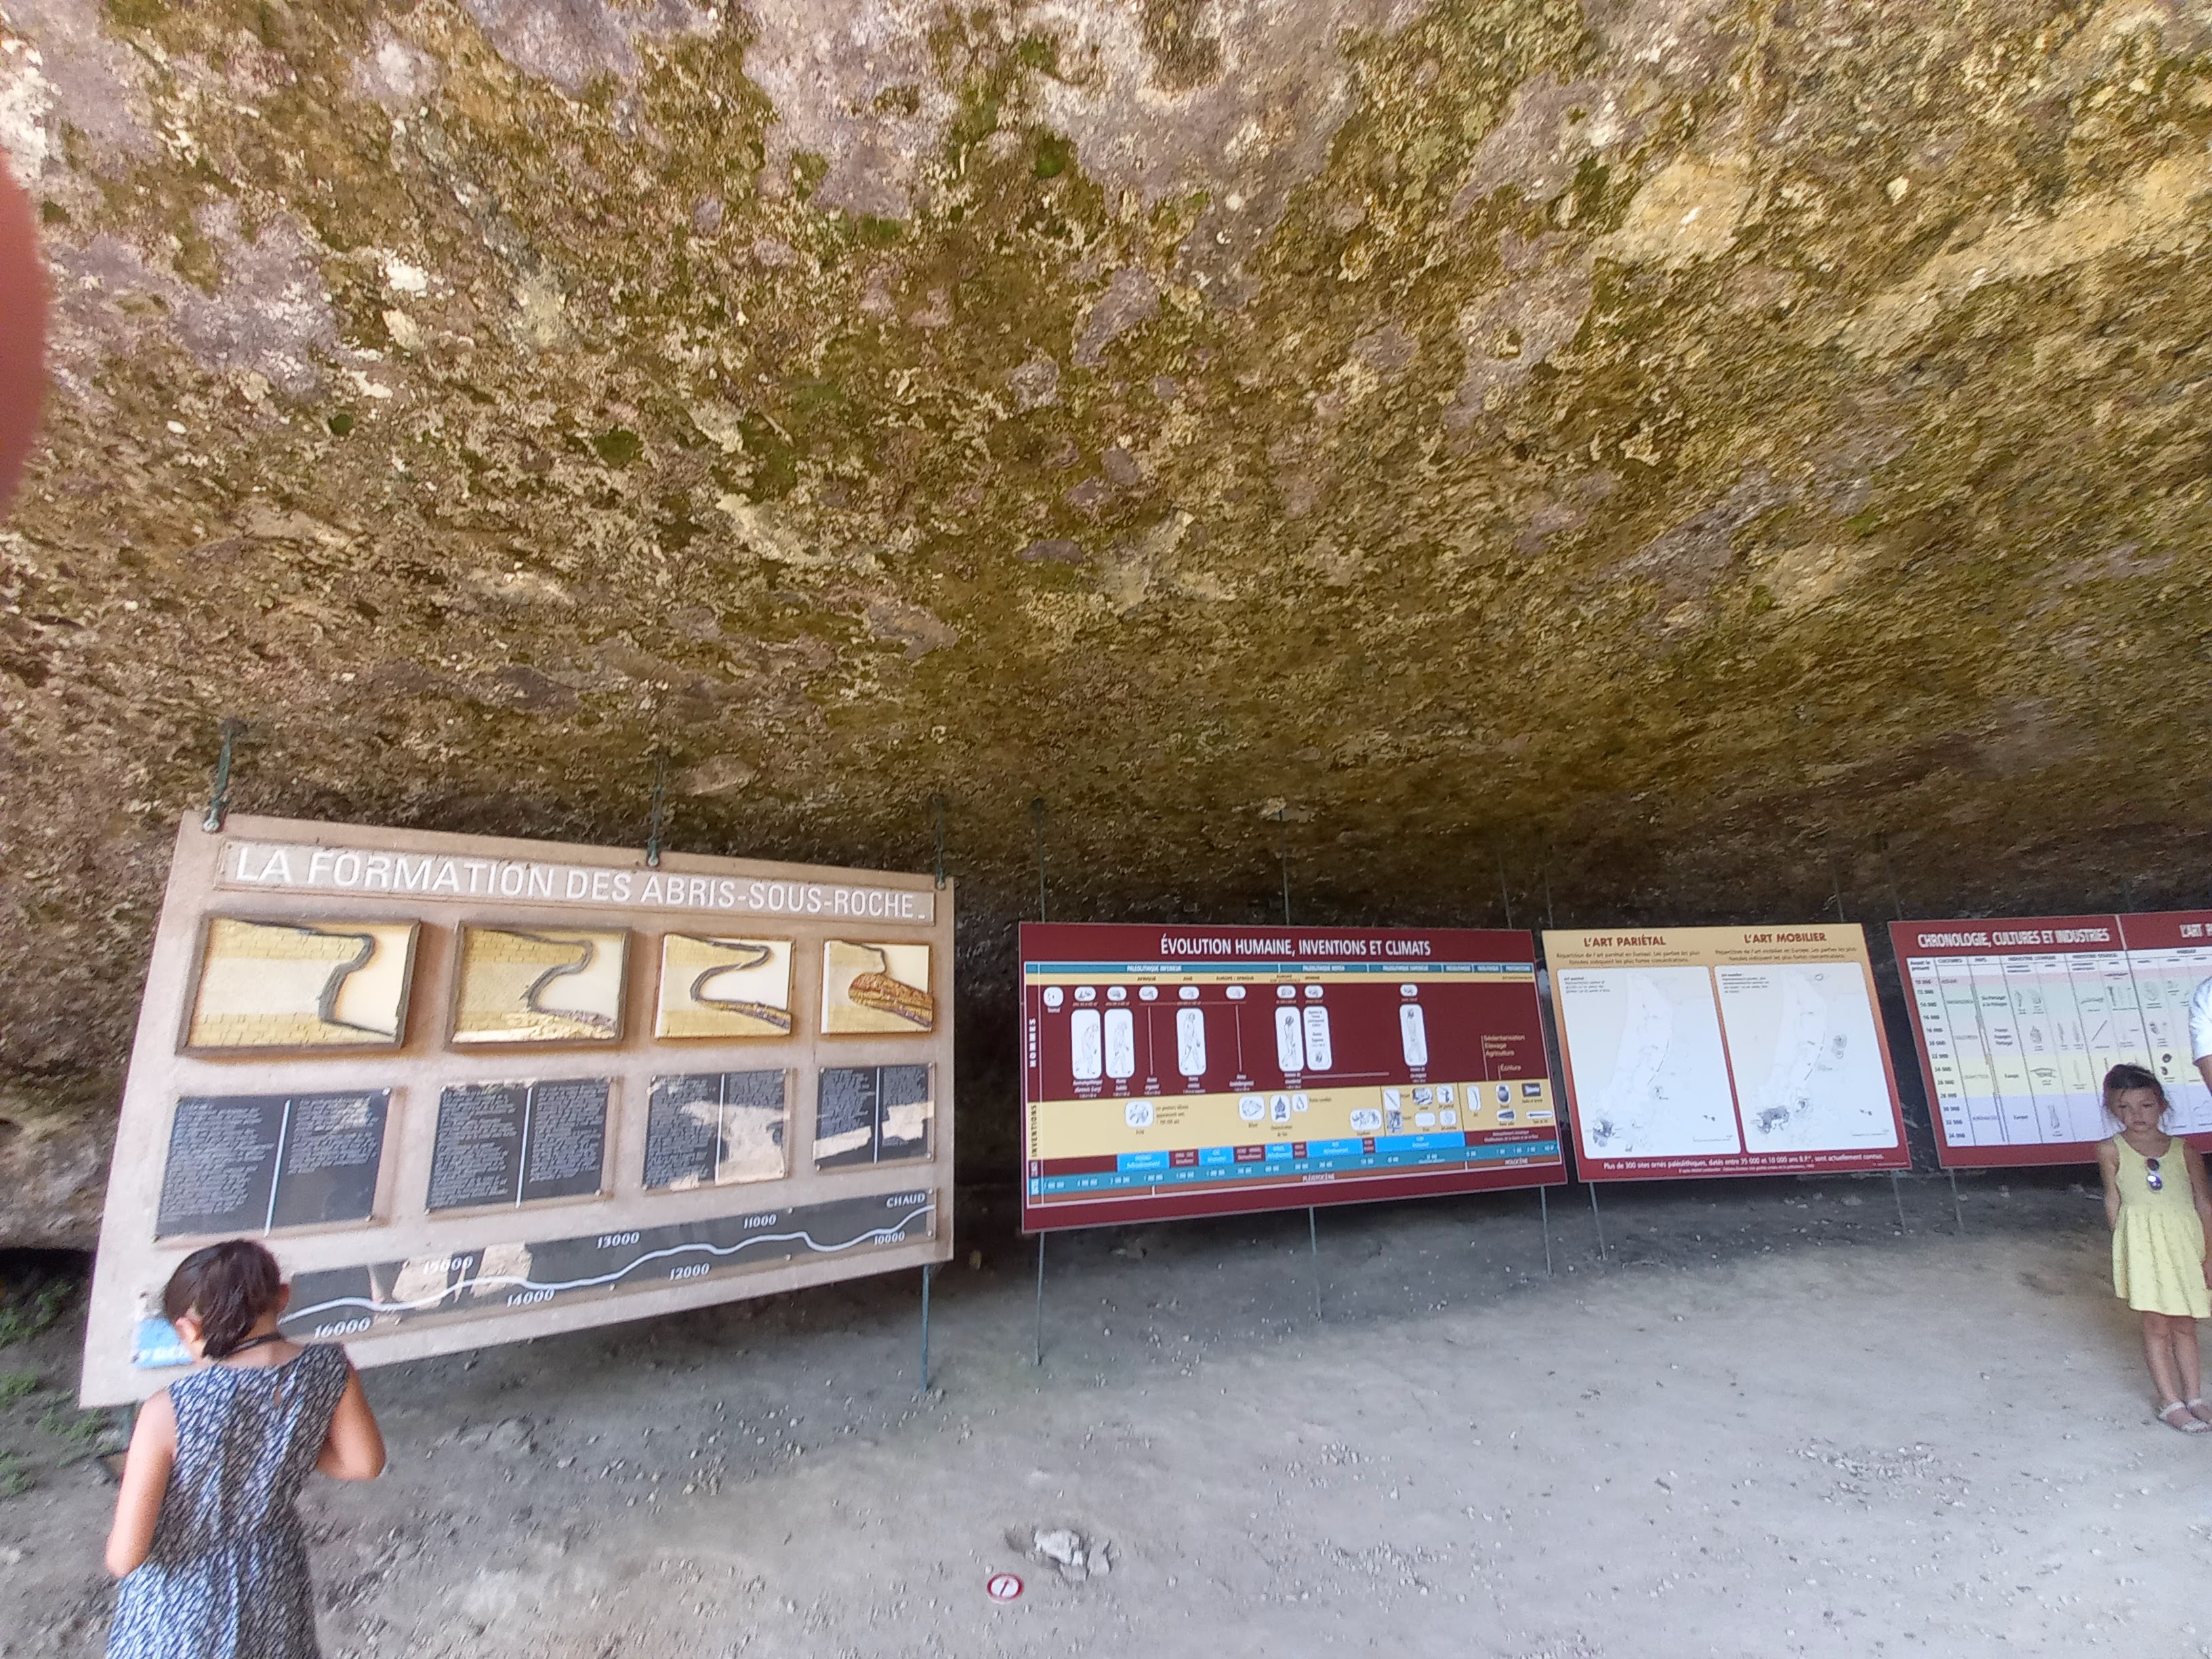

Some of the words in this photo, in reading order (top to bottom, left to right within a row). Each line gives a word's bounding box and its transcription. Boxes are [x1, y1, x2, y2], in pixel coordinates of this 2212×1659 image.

[236, 846, 293, 884] LA
[306, 850, 554, 897] FORMATION
[567, 869, 631, 902] DES
[1160, 933, 1231, 955] ÉVOLUTION
[1235, 938, 1295, 957] HUMAINE,
[1298, 940, 1367, 956] INVENTIONS
[1370, 940, 1382, 956] ET
[1386, 940, 1431, 956] CLIMATS
[1616, 934, 1666, 947] PARIÉTAL
[1776, 933, 1827, 943] MOBILIER
[1917, 933, 1992, 948] CHRONOLOGIE,
[1992, 930, 2040, 946] CULTURES
[2043, 930, 2055, 944] ET
[2055, 928, 2110, 943] INDUSTRIES
[886, 1193, 926, 1208] CHAUD
[743, 1214, 777, 1229] 11000
[596, 1231, 640, 1250] 13000
[874, 1230, 905, 1246] 10000
[423, 1255, 474, 1275] 15000
[669, 1263, 710, 1281] 12000
[507, 1288, 555, 1308] 14000
[314, 1316, 371, 1340] 16000
